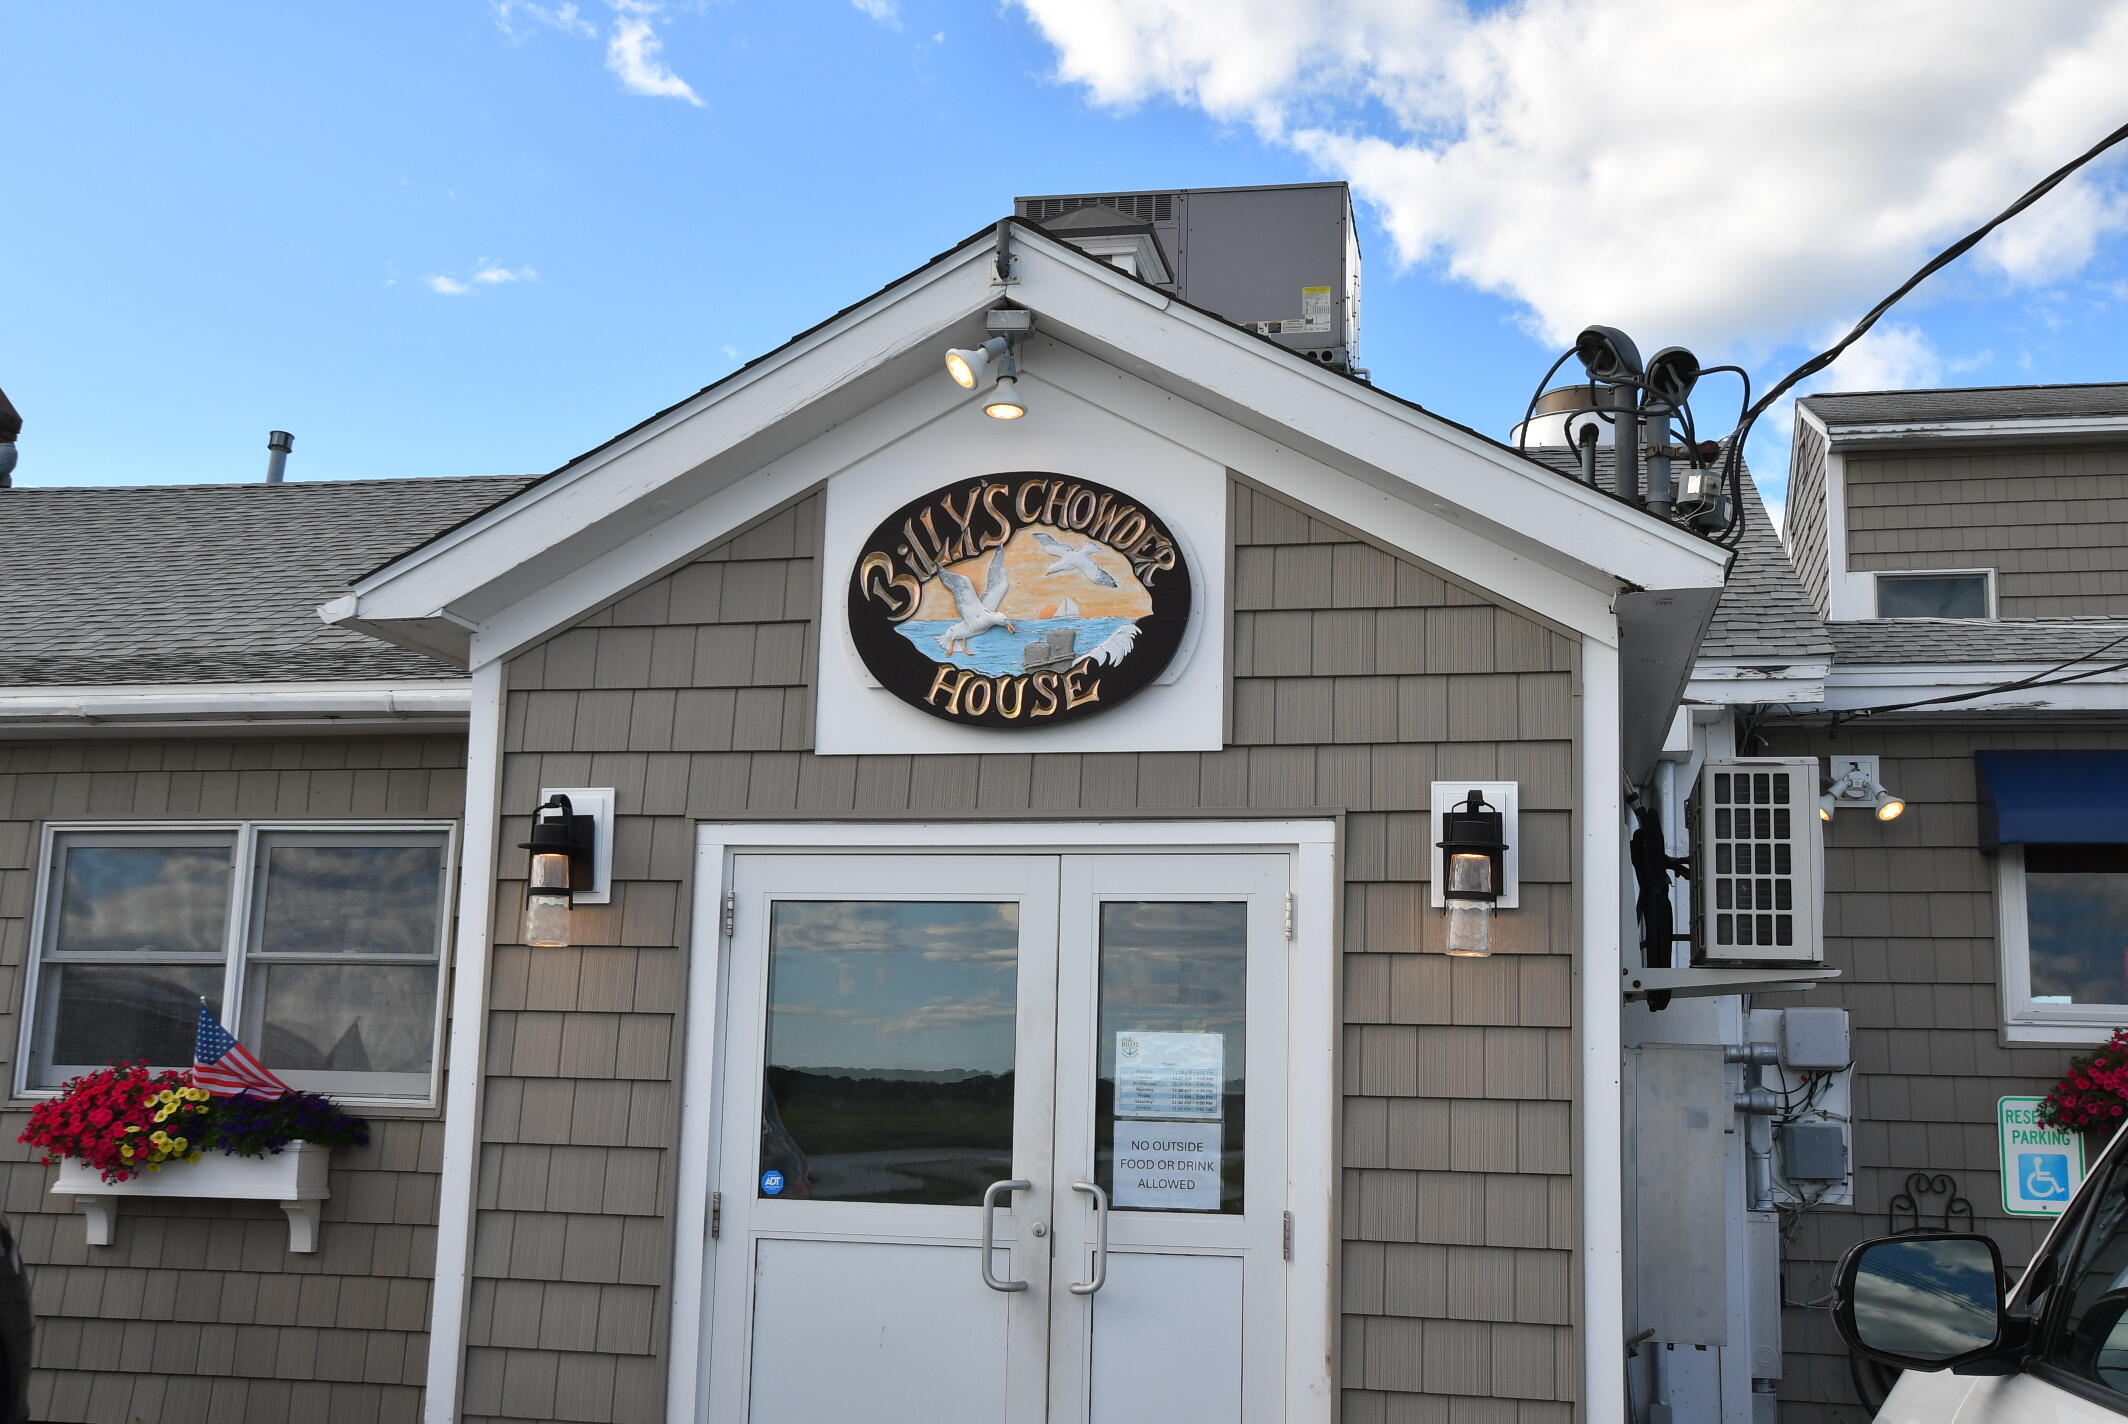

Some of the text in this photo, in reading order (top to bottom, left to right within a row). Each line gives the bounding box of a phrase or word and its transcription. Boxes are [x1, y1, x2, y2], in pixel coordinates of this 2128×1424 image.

[1015, 479, 1176, 587] CHOWDER
[924, 658, 1101, 719] HOUSE
[2012, 1130, 2071, 1146] PARKING
[1131, 1140, 1204, 1153] NO OUTSIDE
[1120, 1159, 1215, 1172] FOOD OR DRINK
[764, 1176, 782, 1186] ADT
[1137, 1178, 1196, 1190] ALLOWED
